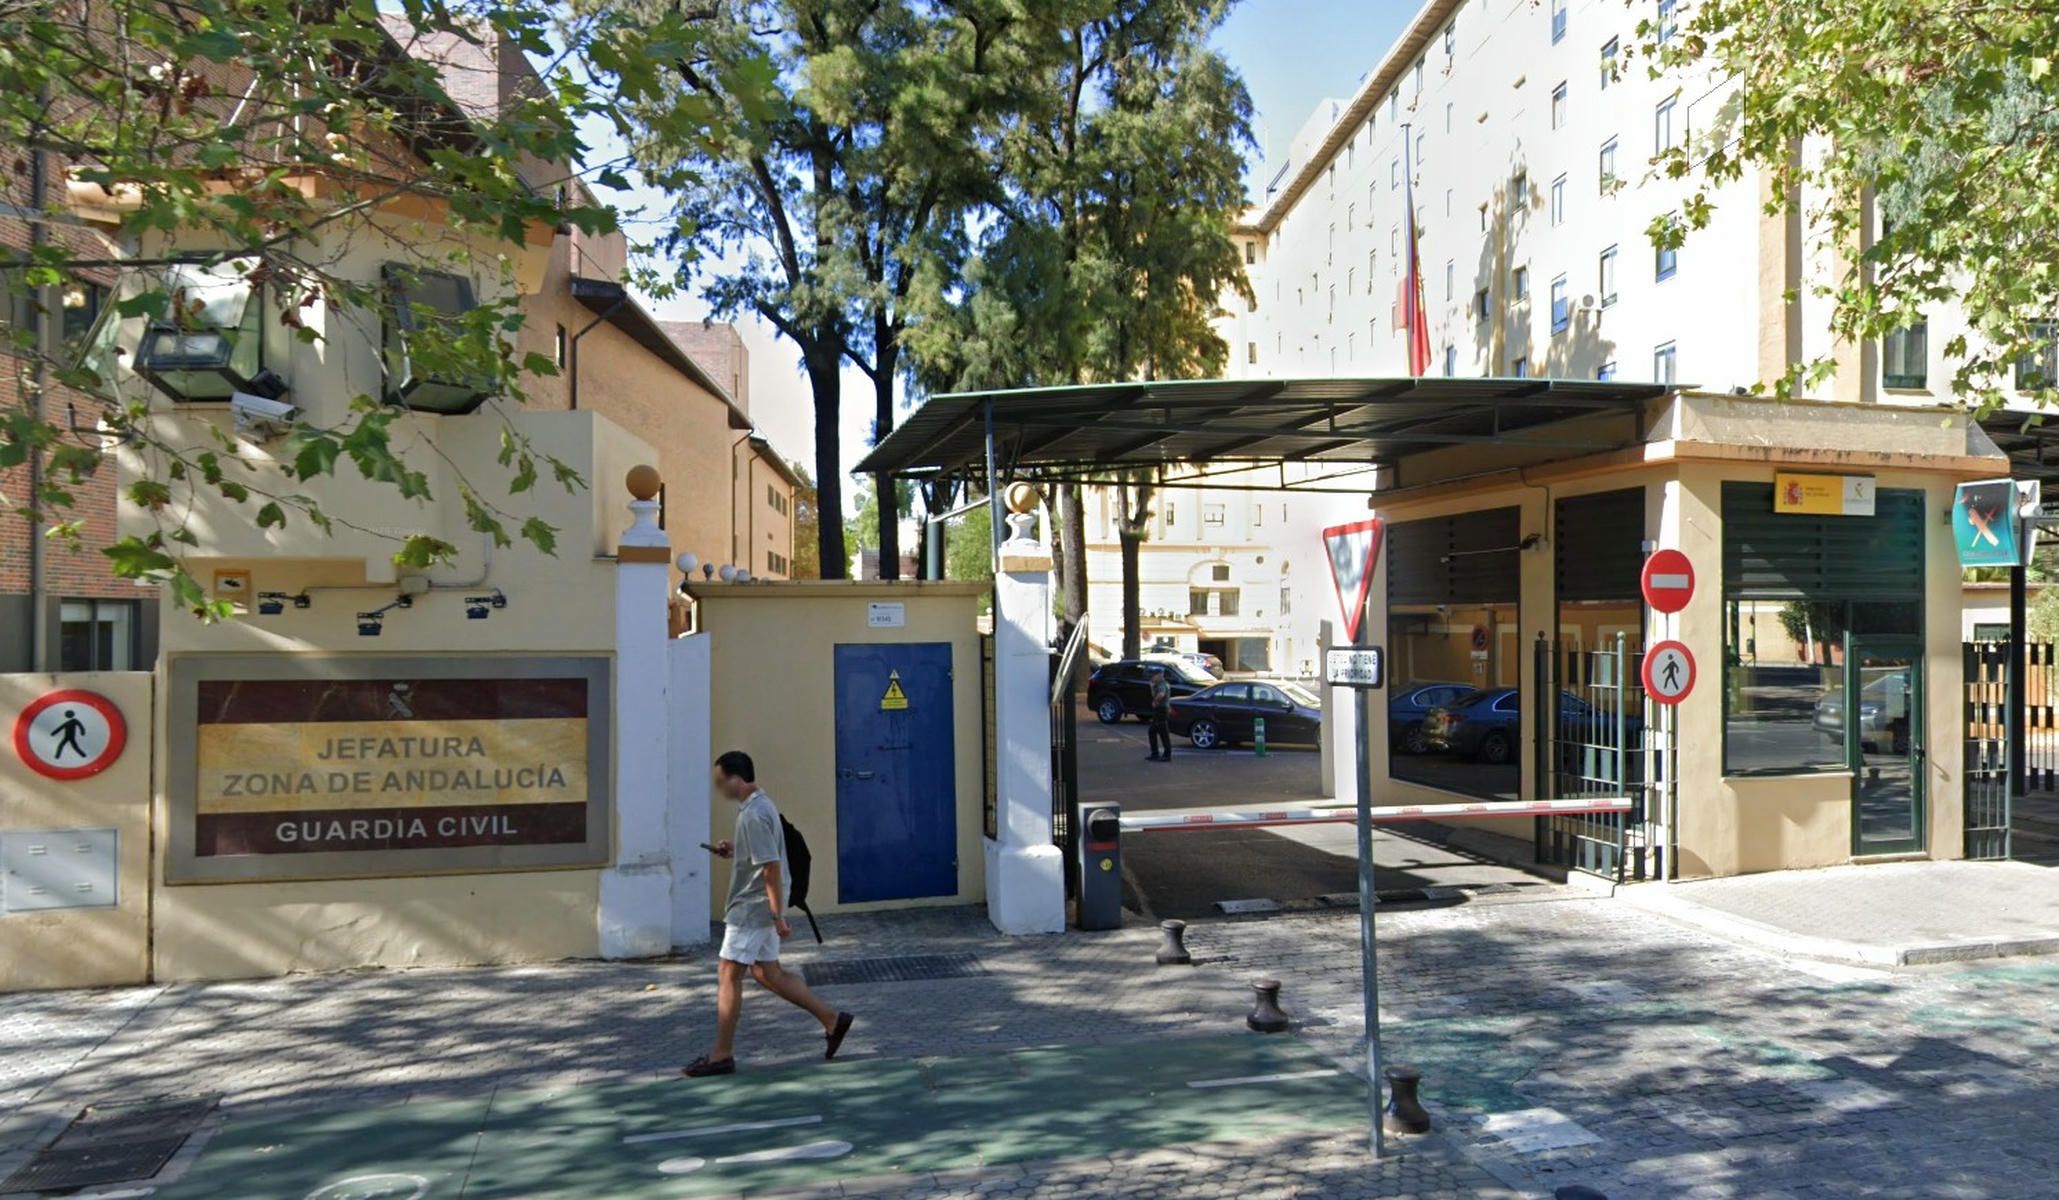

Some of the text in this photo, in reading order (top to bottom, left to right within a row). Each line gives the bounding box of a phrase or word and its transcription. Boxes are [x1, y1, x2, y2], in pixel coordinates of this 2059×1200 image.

[317, 736, 486, 761] JEFATURA
[222, 763, 567, 797] ZONA DE ANDALUCÍA
[275, 815, 518, 843] GUARDIA CIVIL
